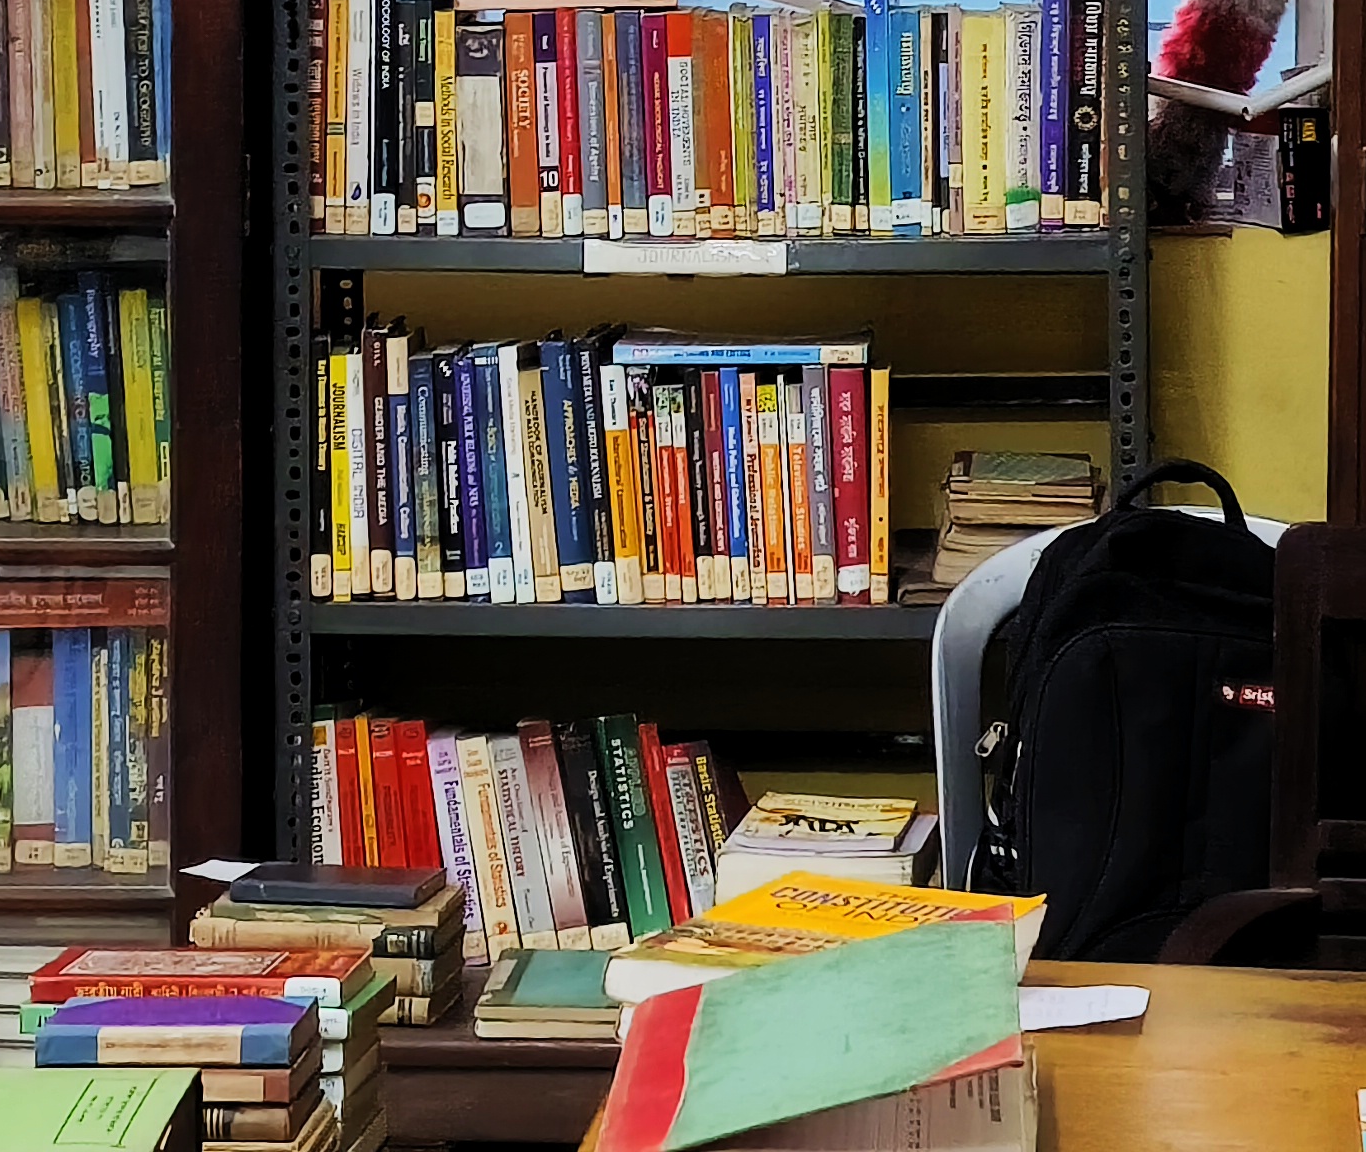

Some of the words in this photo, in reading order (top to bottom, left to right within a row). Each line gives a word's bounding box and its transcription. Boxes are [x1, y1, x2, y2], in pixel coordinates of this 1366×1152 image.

[352, 67, 364, 107] Widows
[381, 64, 391, 89] INDIA
[439, 75, 454, 117] Methods
[518, 68, 531, 129] SOCIETY
[670, 106, 680, 139] INDIA
[441, 130, 455, 158] Social
[441, 158, 455, 201] Research
[540, 170, 558, 188] 10
[372, 341, 382, 367] GILL
[579, 351, 593, 375] PRINT
[581, 375, 595, 403] MEDIA
[331, 382, 346, 452] JOURNALISM
[373, 396, 385, 441] GENDER
[416, 385, 431, 477] Communicating
[529, 390, 541, 441] HANDBOOK
[584, 403, 597, 421] AND
[351, 427, 364, 478] DIGITAL
[375, 442, 386, 467] AND
[764, 448, 777, 487] Public
[376, 467, 387, 490] THE
[746, 452, 761, 514] Professional
[792, 446, 805, 504] Television
[352, 484, 365, 519] INDIA
[376, 490, 388, 526] MEDIA
[766, 488, 778, 546] Relations
[795, 507, 807, 550] Studies
[587, 770, 599, 798] Design
[610, 737, 635, 830] STATISTICS
[695, 755, 712, 792] Basic
[443, 780, 468, 854] Fundamentals
[498, 768, 518, 834] STATISTICAL
[455, 856, 470, 868] of
[490, 863, 507, 909] Statistics
